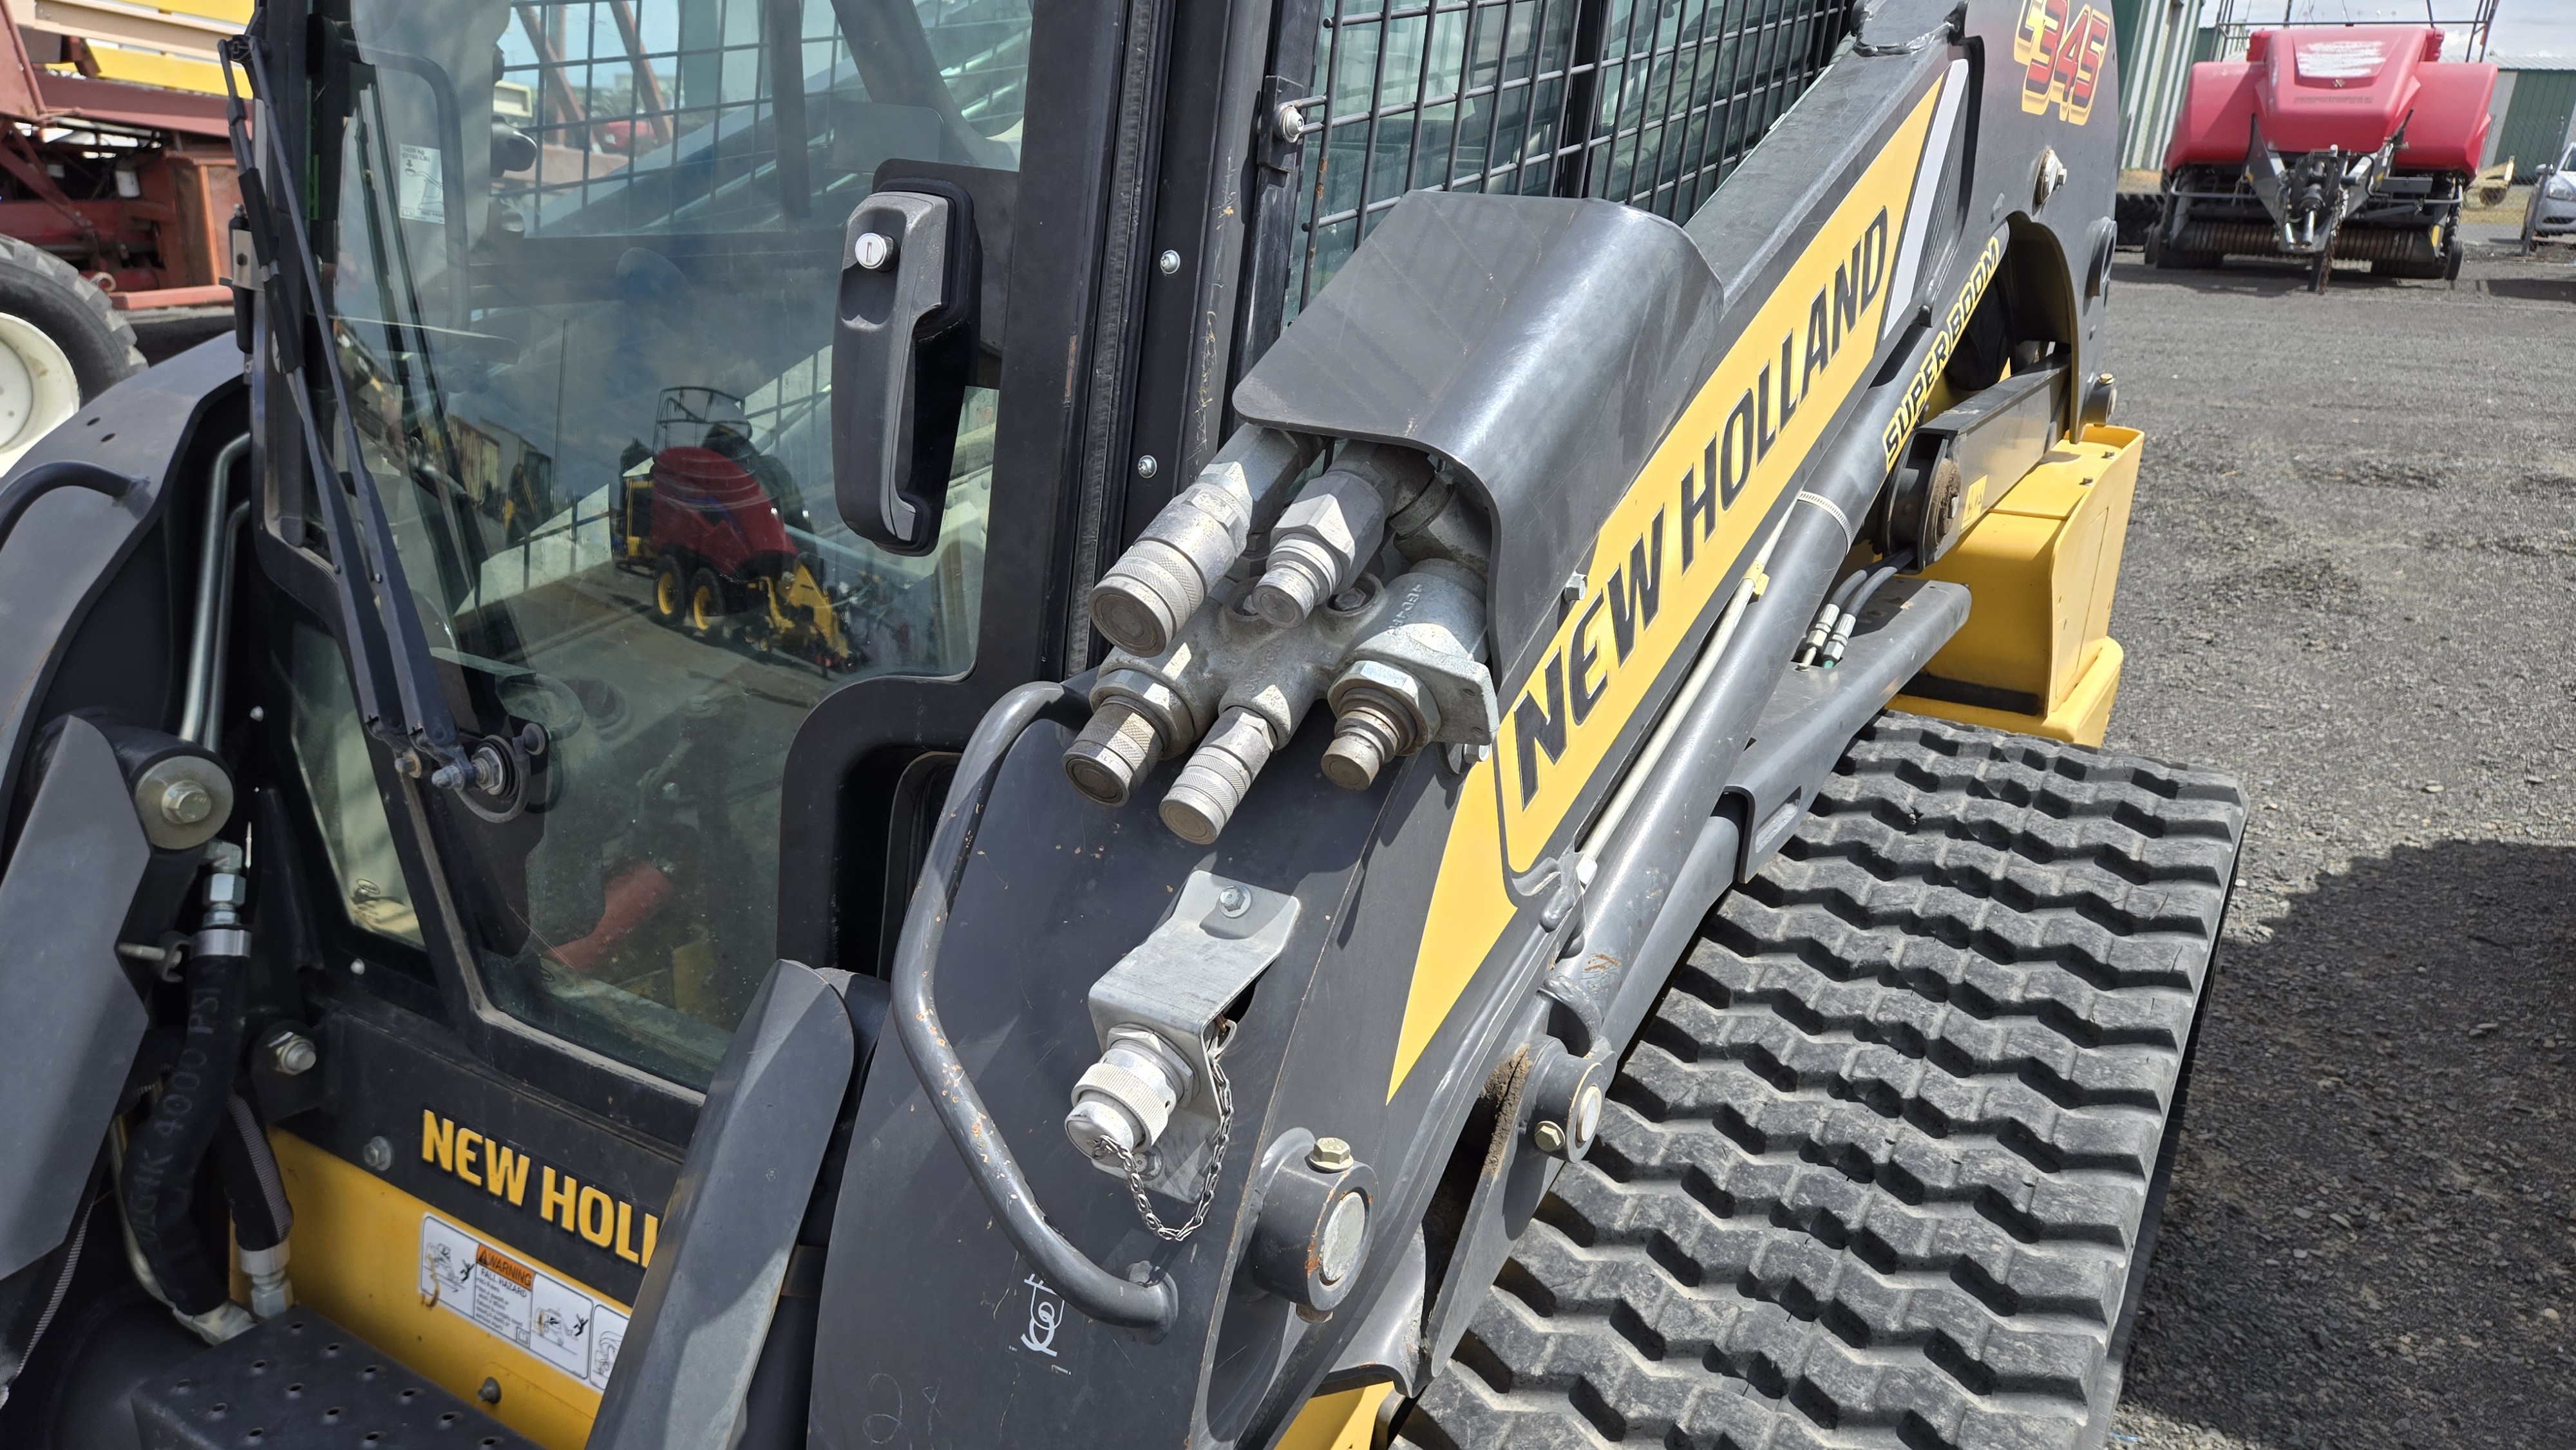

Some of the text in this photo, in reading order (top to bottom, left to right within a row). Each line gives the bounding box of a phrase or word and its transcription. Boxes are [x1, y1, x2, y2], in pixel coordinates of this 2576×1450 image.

[1882, 236, 2000, 471] SUPER BOOM
[1513, 205, 1888, 812] NEW HOLLAND
[422, 1109, 658, 1269] NEW HOLL
[481, 1268, 498, 1283] FALL
[499, 1278, 527, 1297] HAZARD
[488, 1254, 532, 1286] WARNING
